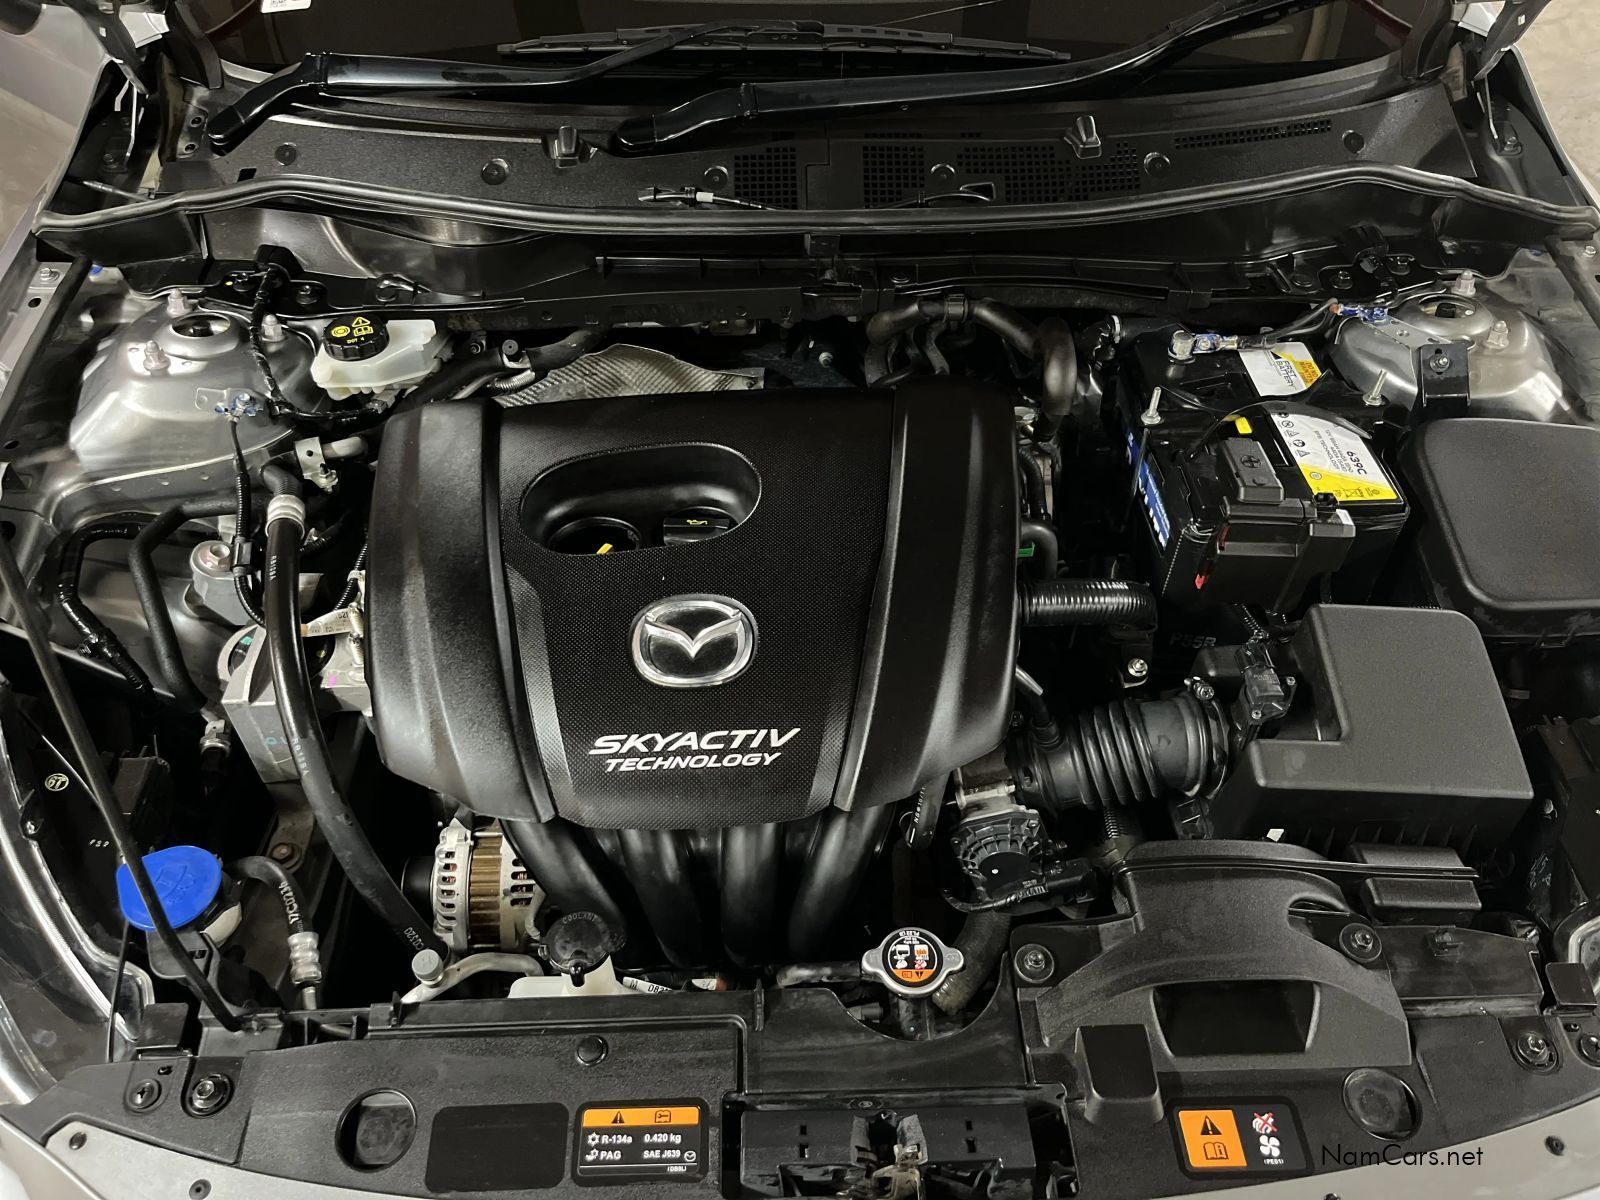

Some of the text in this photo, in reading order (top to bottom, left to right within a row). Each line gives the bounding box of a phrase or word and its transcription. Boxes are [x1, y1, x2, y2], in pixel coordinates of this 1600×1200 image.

[1276, 361, 1295, 388] BATTERY
[1346, 450, 1367, 476] 639C
[589, 728, 801, 755] SKYACTIV
[604, 752, 782, 772] TECHNOLOGY
[562, 912, 598, 924] COOLANT
[602, 1133, 682, 1144] R-134a 0.420 kg
[600, 1150, 681, 1160] PAG SAE J639
